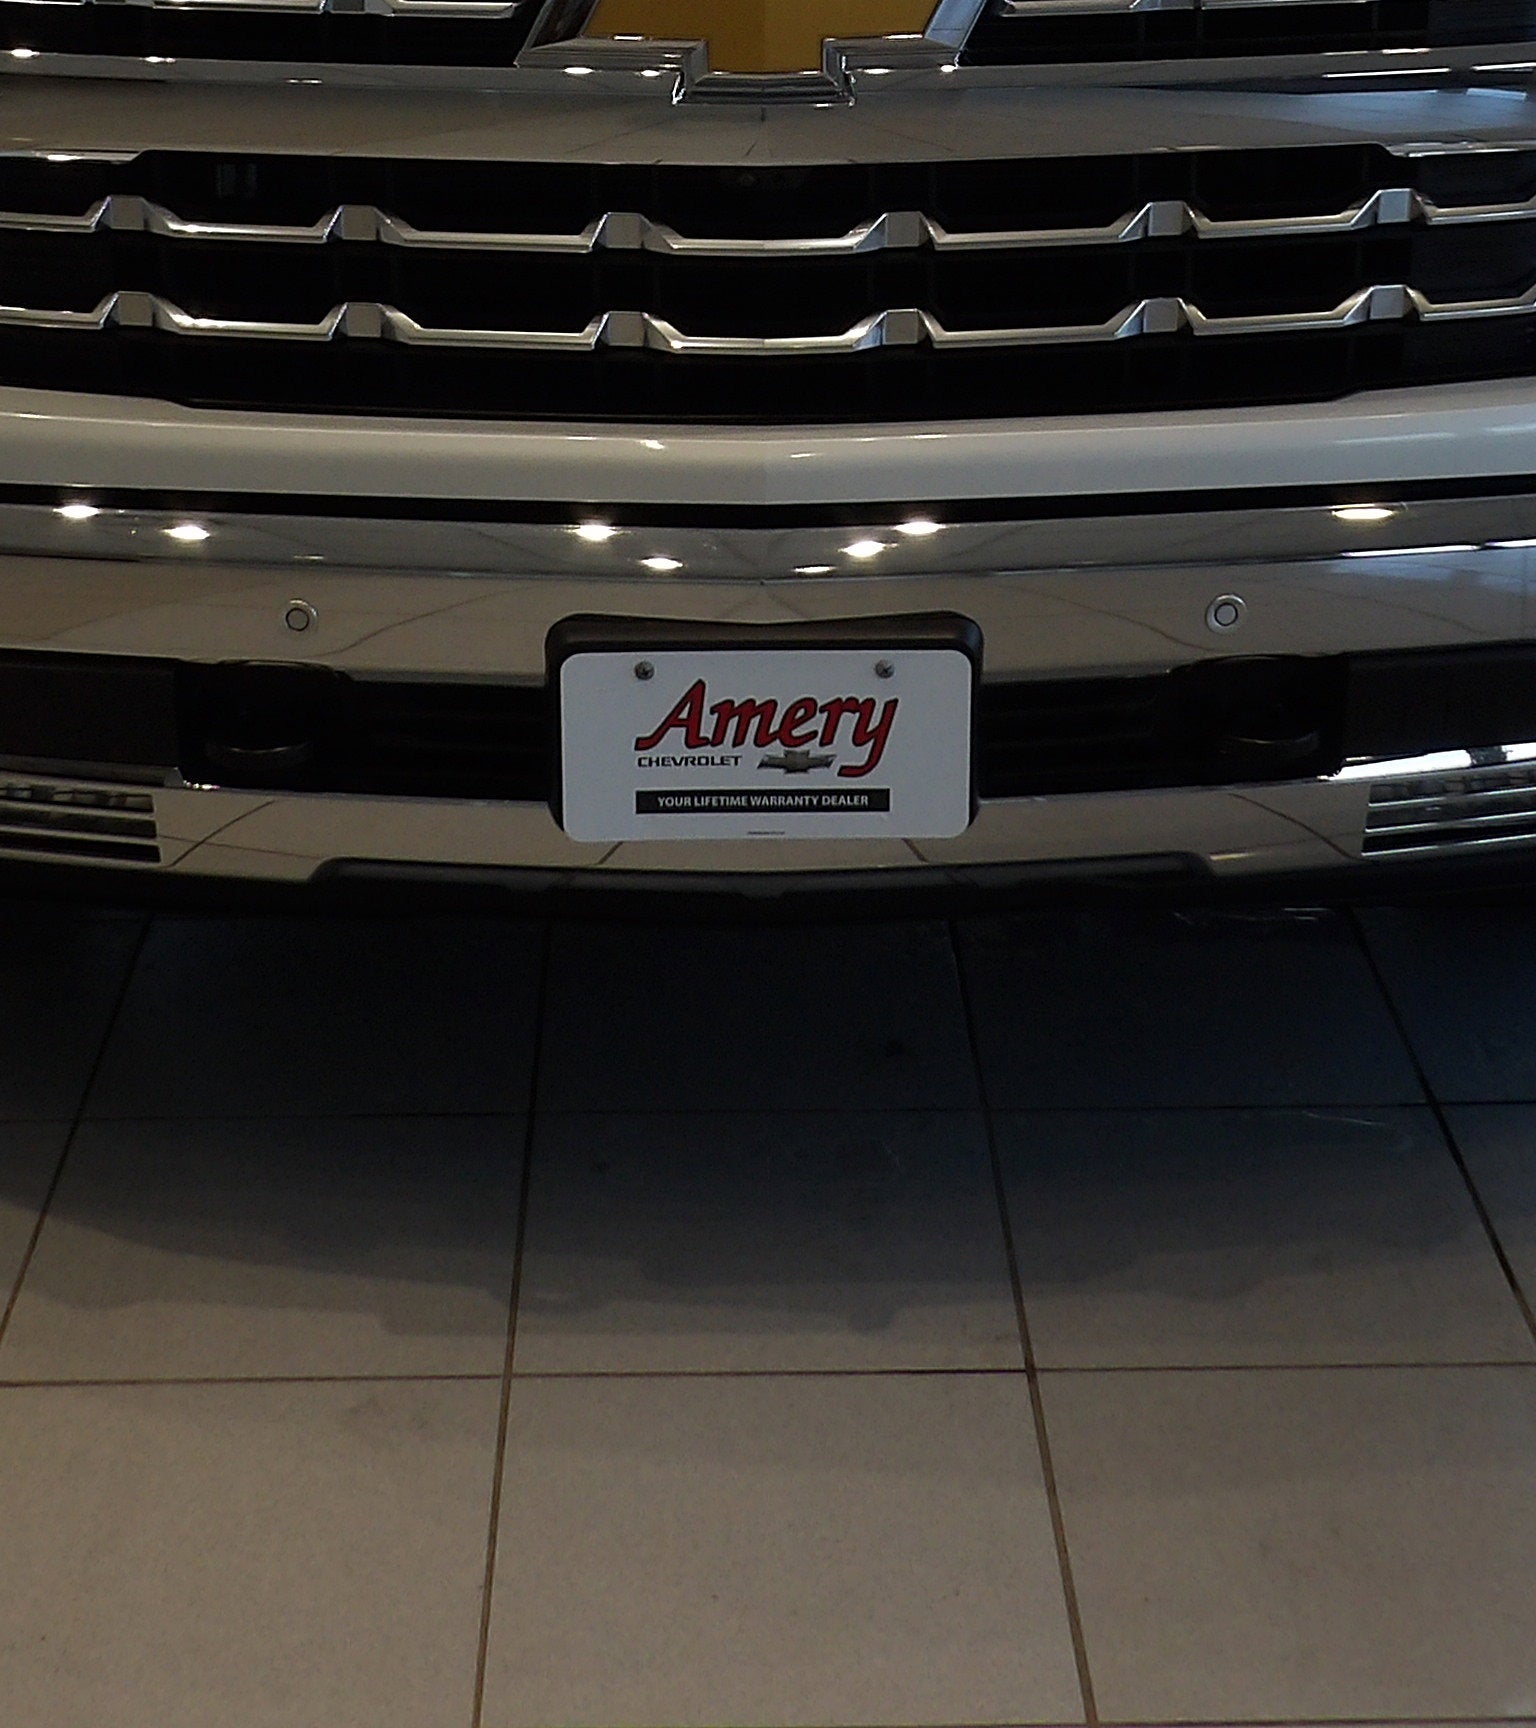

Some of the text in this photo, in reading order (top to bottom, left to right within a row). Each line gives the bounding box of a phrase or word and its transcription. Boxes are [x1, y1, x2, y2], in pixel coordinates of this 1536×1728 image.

[634, 678, 899, 778] Amery
[637, 755, 743, 768] CHEVROLET
[657, 794, 869, 808] YOUR LIFETIME WARRANTY DEALER
